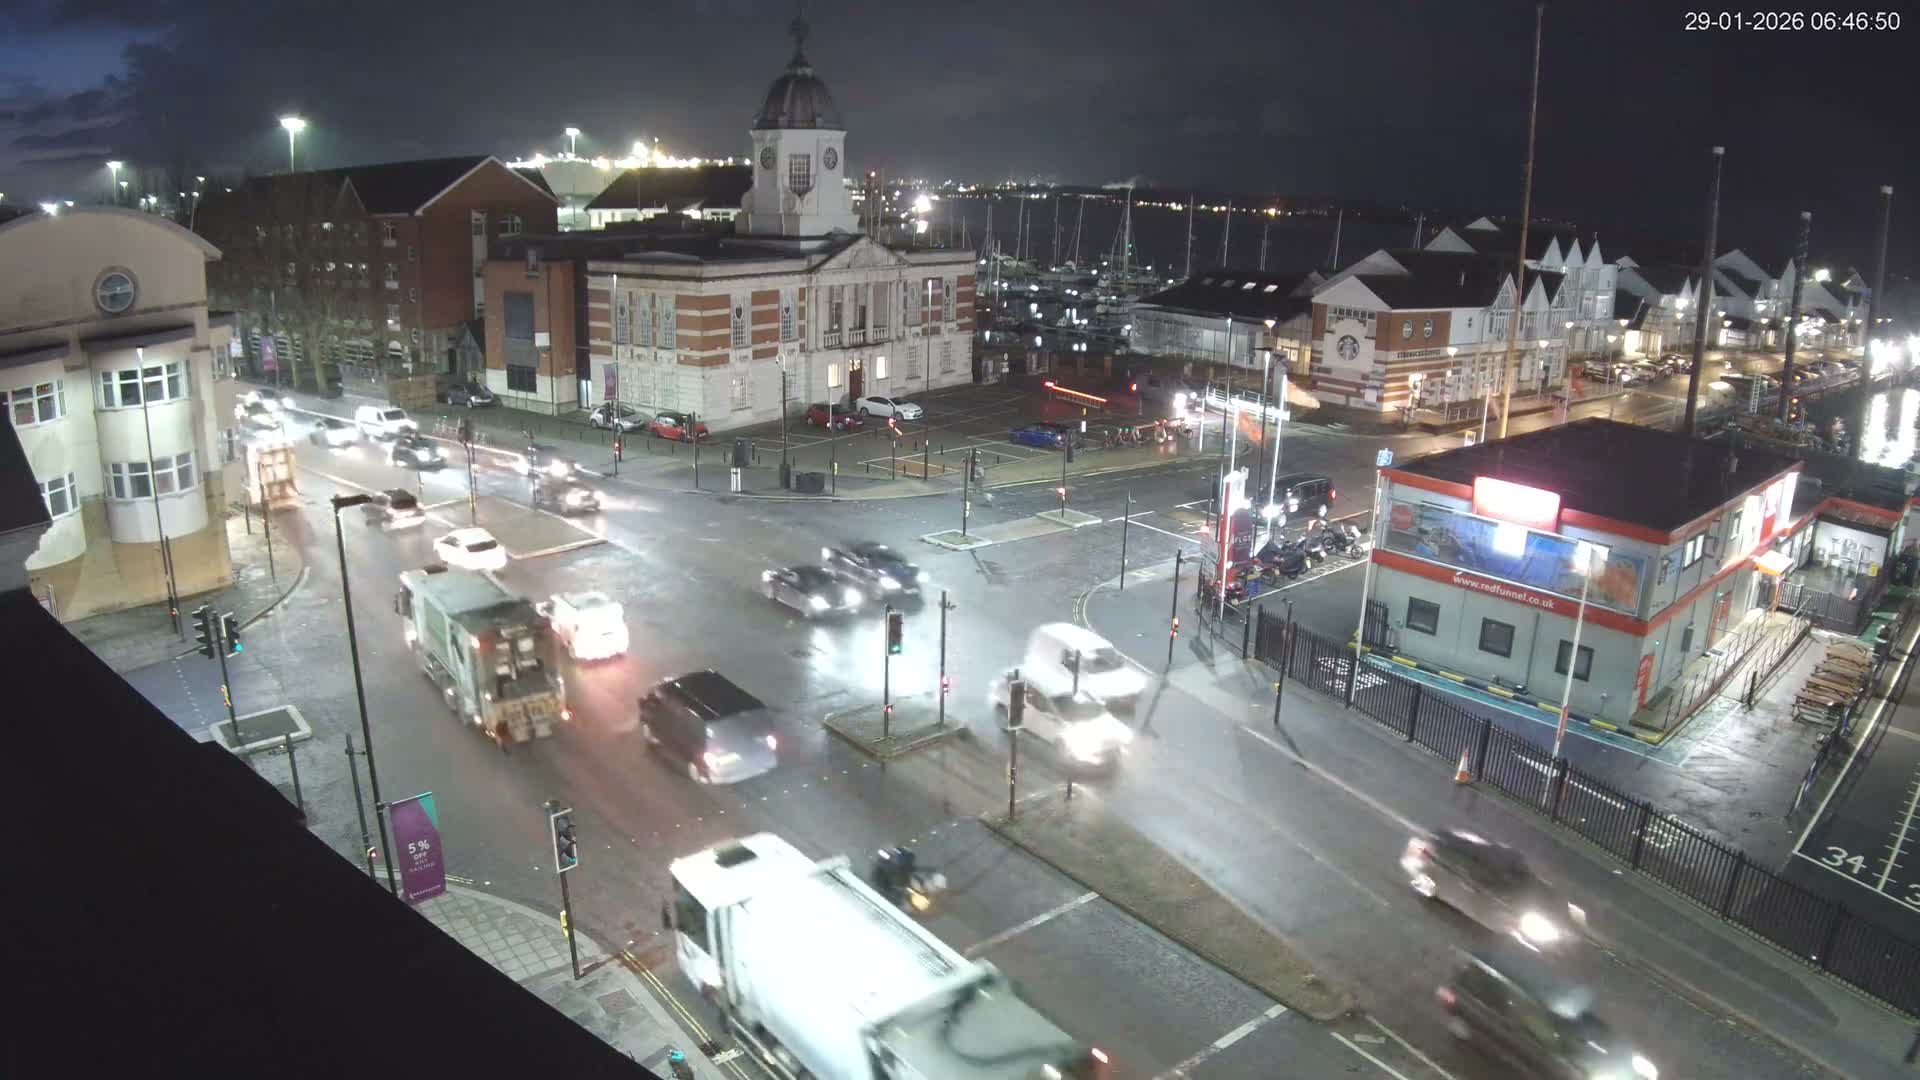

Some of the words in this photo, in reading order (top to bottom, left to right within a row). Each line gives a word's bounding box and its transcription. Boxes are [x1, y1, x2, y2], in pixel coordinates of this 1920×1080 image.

[1453, 575, 1554, 609] www.redfunnel.co.uk
[413, 851, 427, 861] OFF
[1822, 846, 1867, 875] 34
